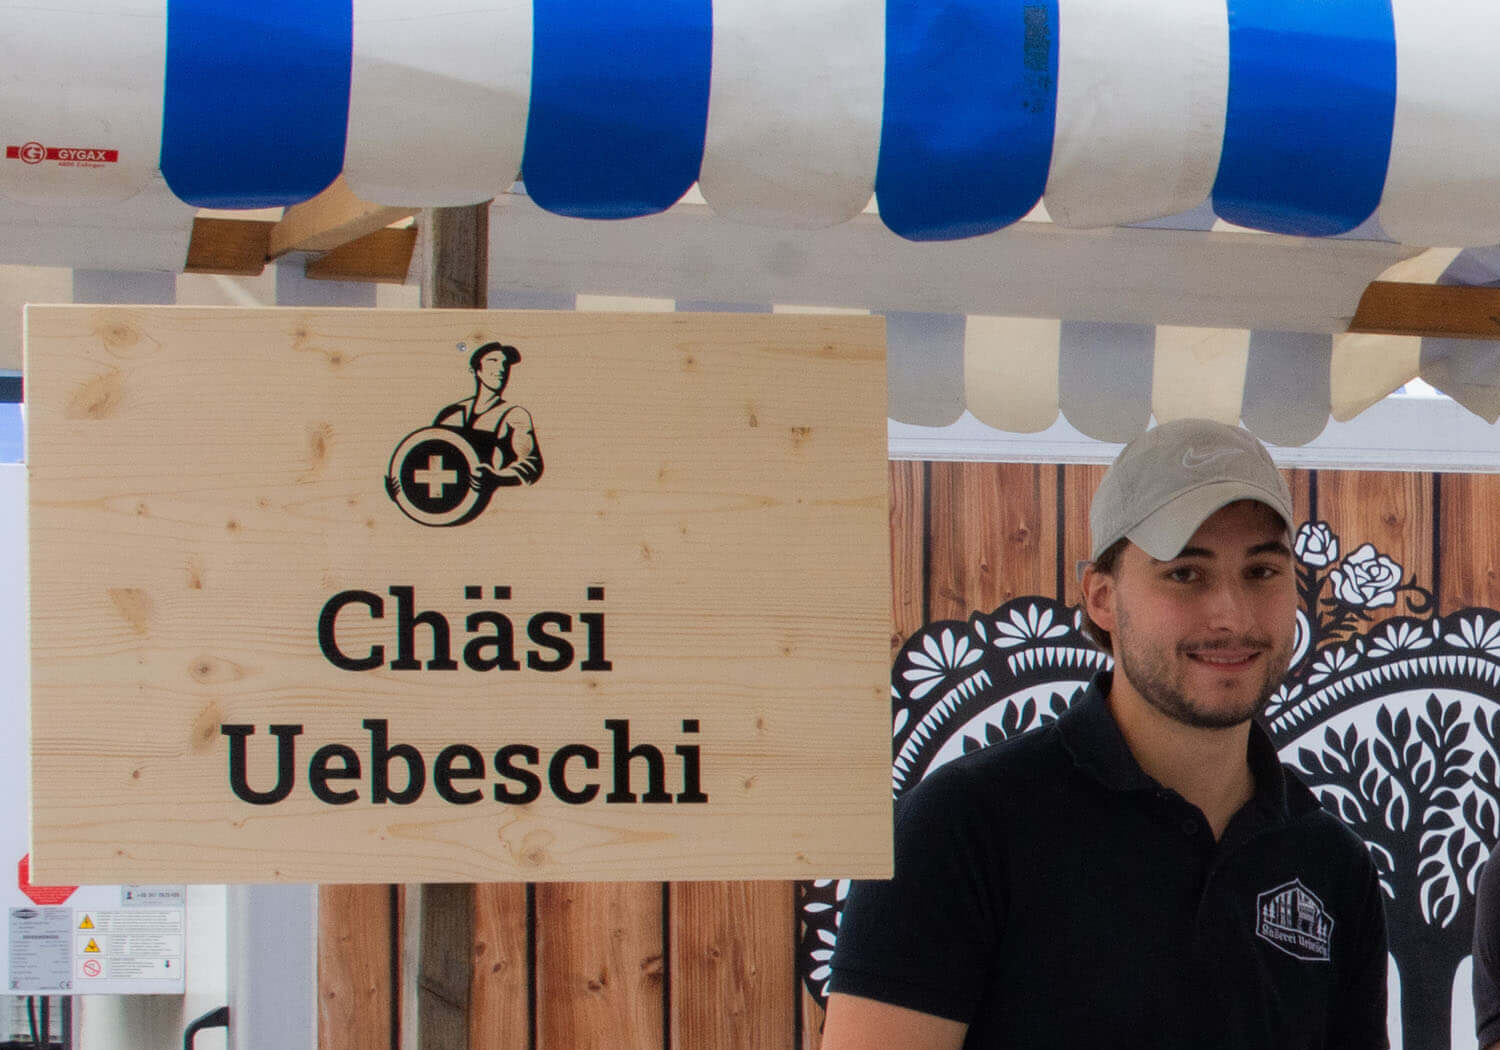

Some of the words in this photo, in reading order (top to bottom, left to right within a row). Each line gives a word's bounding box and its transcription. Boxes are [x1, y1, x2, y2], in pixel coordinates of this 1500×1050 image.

[58, 149, 106, 161] GYGAX
[317, 585, 613, 673] Chäsi
[220, 719, 709, 805] Uebeschi
